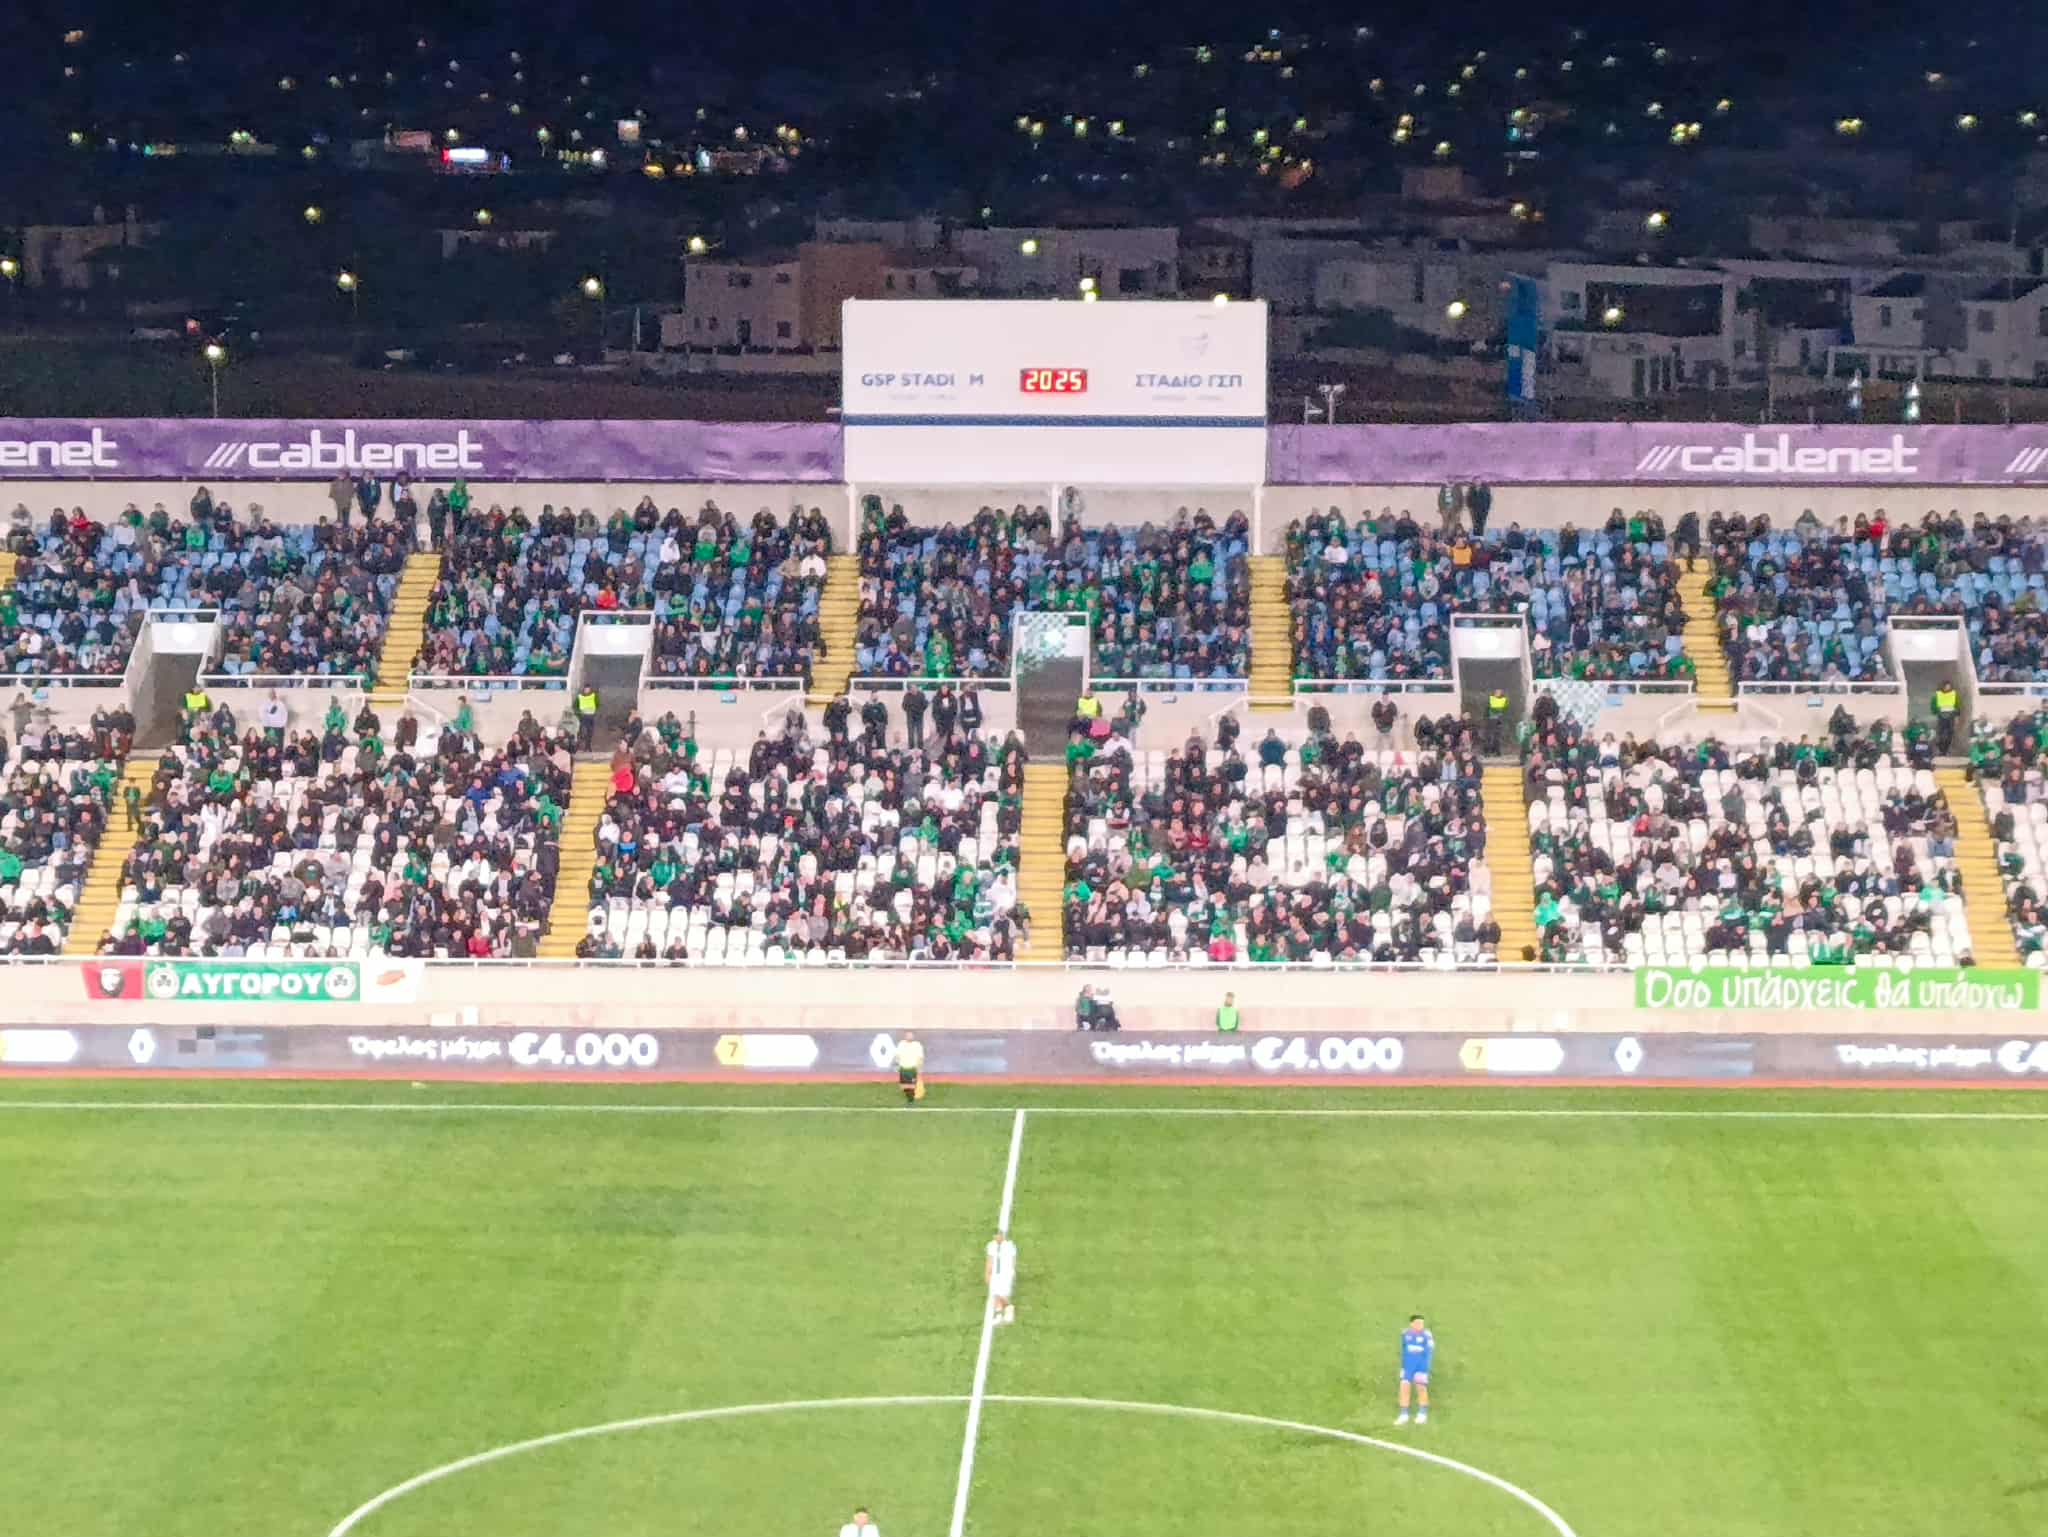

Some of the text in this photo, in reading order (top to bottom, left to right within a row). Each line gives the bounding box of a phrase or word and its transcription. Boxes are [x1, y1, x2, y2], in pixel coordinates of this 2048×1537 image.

[861, 373, 984, 387] GSP STADIM
[1135, 374, 1242, 388] ΣΤΑΔΙΟ ΓΣΠ
[247, 429, 484, 469] cablenet
[1680, 433, 1919, 474] cablenet
[181, 973, 323, 995] ΑΥΓΟΡΟΥ
[508, 1032, 659, 1065] €4.000
[1251, 1037, 1404, 1070] €4.000
